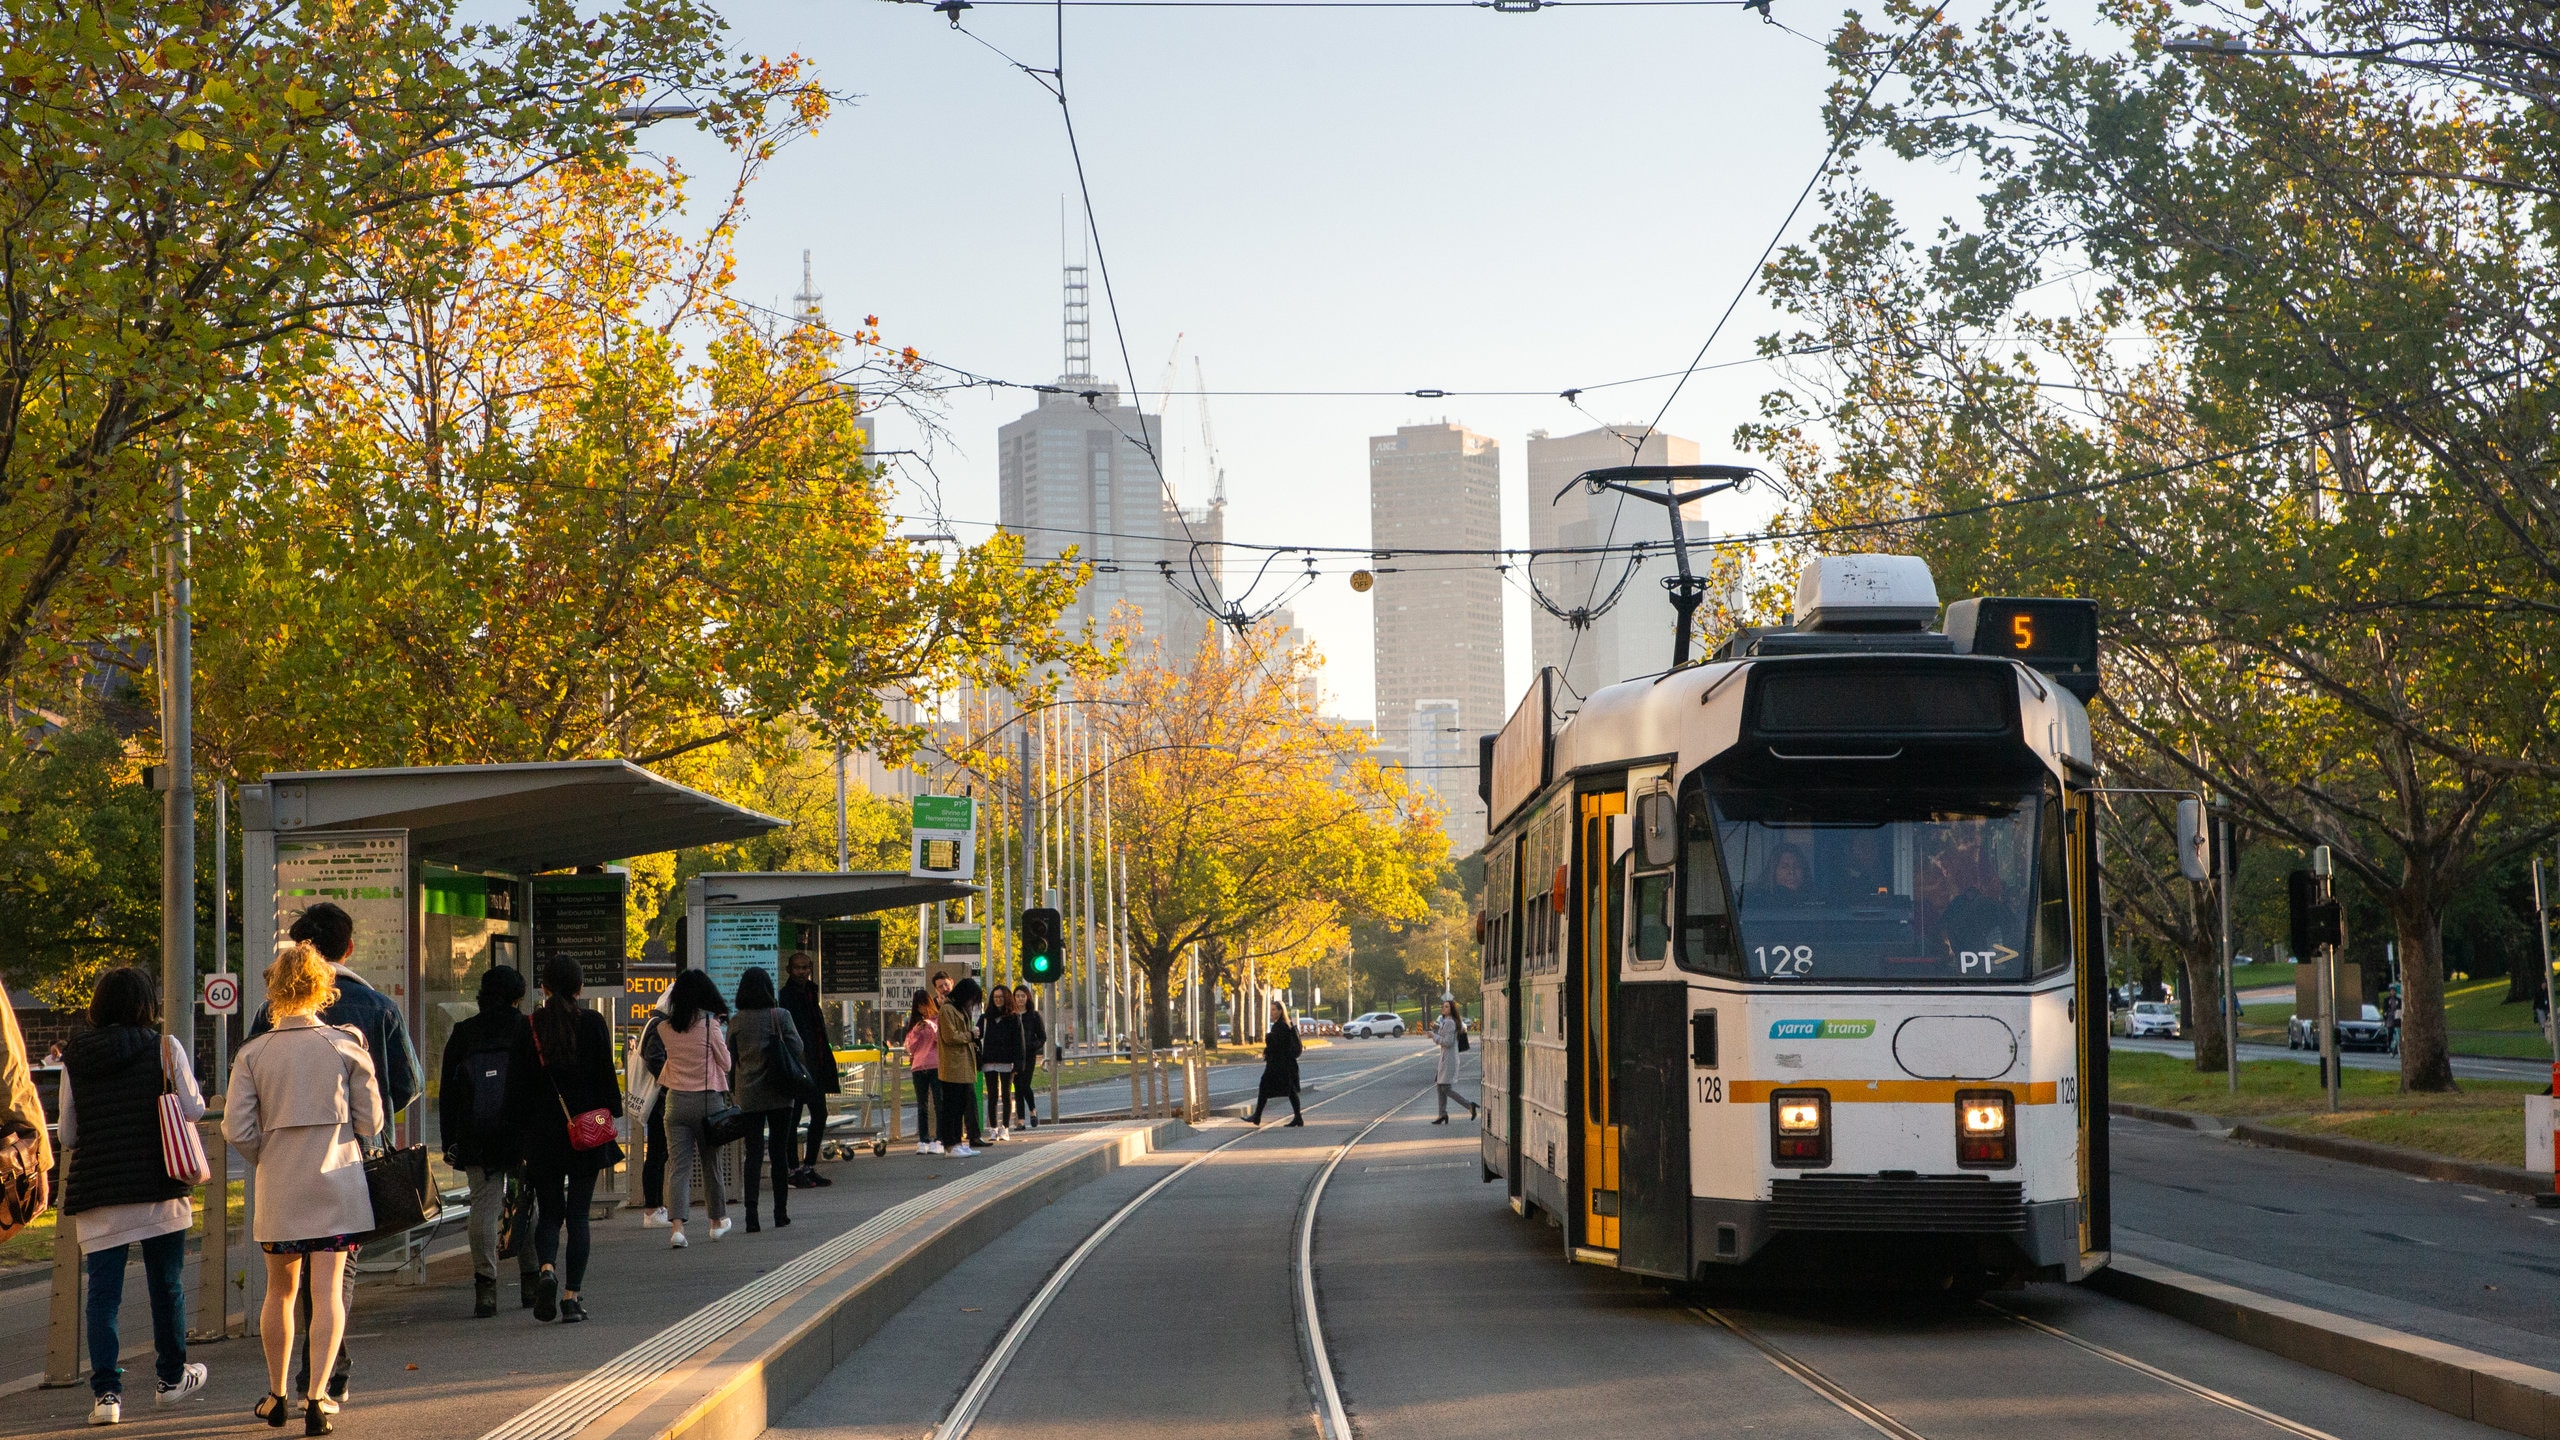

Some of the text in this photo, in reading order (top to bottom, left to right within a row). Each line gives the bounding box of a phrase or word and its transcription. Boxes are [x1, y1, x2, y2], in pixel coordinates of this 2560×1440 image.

[1375, 442, 1397, 452] ANZ
[2014, 616, 2032, 649] 5
[594, 935, 606, 943] Uni
[972, 961, 979, 969] 19
[1754, 945, 1813, 975] 128
[626, 977, 674, 993] DETOU
[886, 986, 900, 998] NOT
[211, 987, 231, 1001] 60
[1777, 1020, 1867, 1037] yarra trams
[1697, 1076, 1722, 1103] 128
[2061, 1076, 2075, 1104] 128
